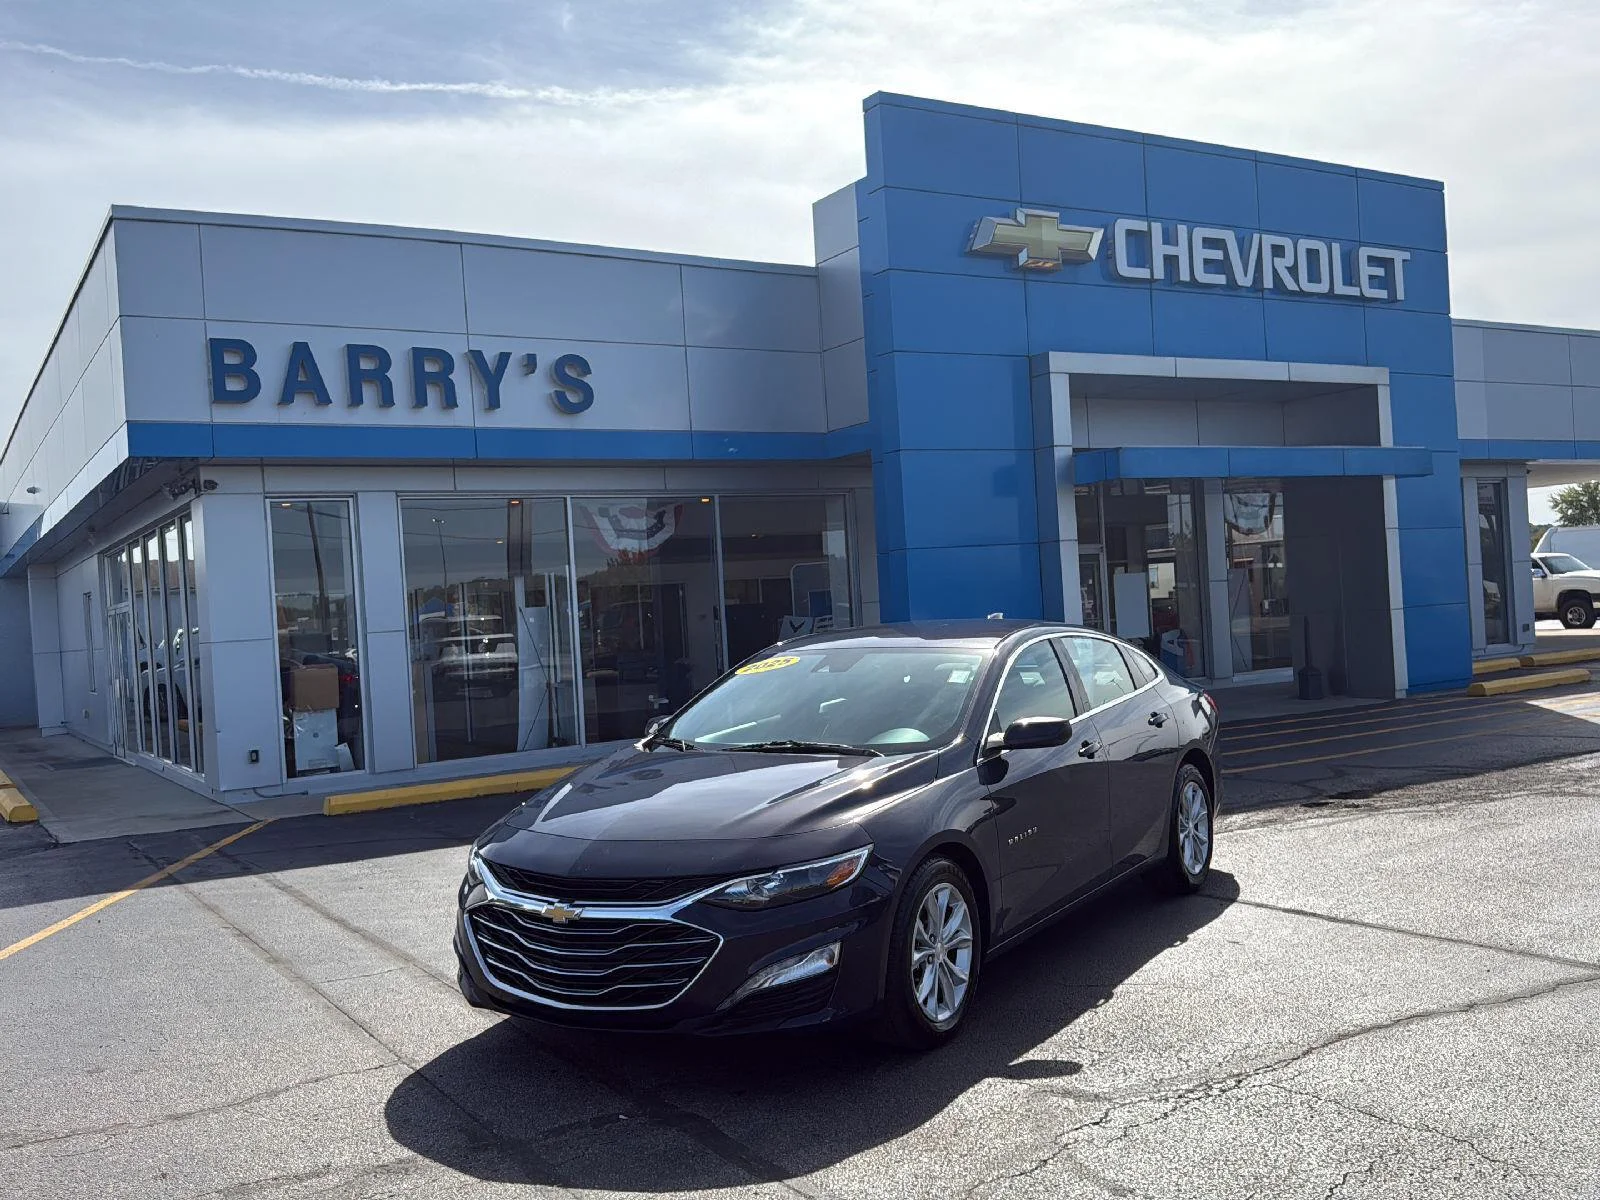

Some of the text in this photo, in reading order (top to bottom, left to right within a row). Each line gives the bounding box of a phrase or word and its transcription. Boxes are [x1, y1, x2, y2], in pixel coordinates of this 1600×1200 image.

[1113, 217, 1412, 302] CHEVROLET
[208, 337, 594, 415] BARRY'S
[741, 656, 796, 673] 2025
